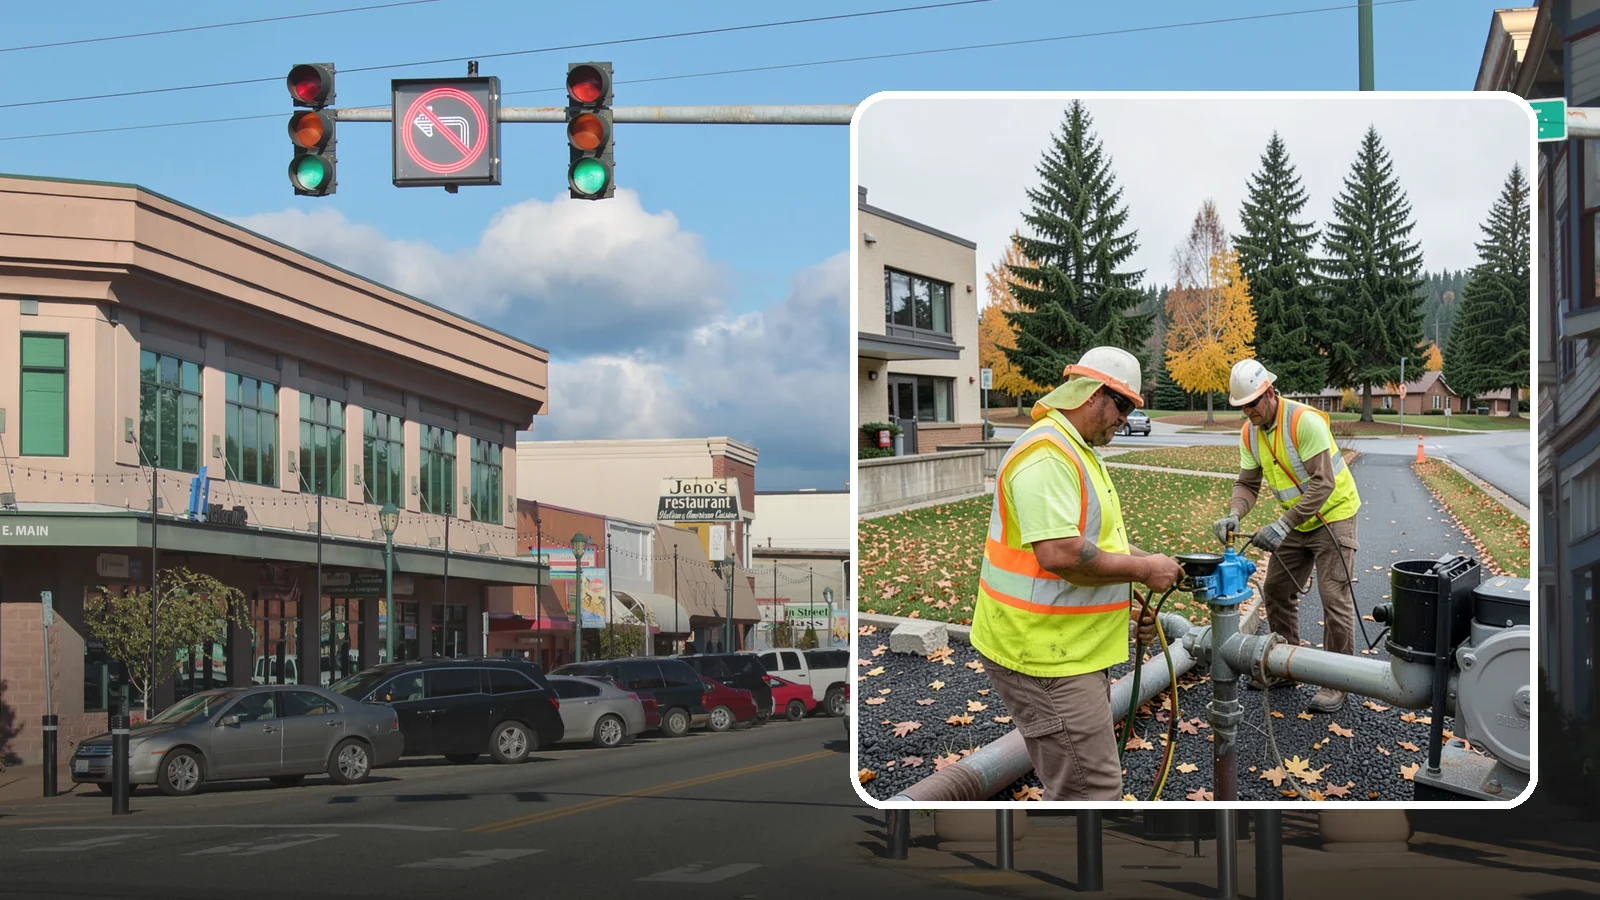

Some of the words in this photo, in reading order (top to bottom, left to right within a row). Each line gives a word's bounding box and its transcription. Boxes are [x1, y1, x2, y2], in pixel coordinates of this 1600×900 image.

[670, 480, 727, 494] Jeno's
[665, 497, 731, 509] restaurant
[658, 510, 681, 519] Italian
[686, 510, 714, 519] American
[715, 510, 738, 519] Cuisine
[2, 525, 13, 536] E.
[15, 525, 49, 536] MAIN
[797, 608, 828, 617] Street
